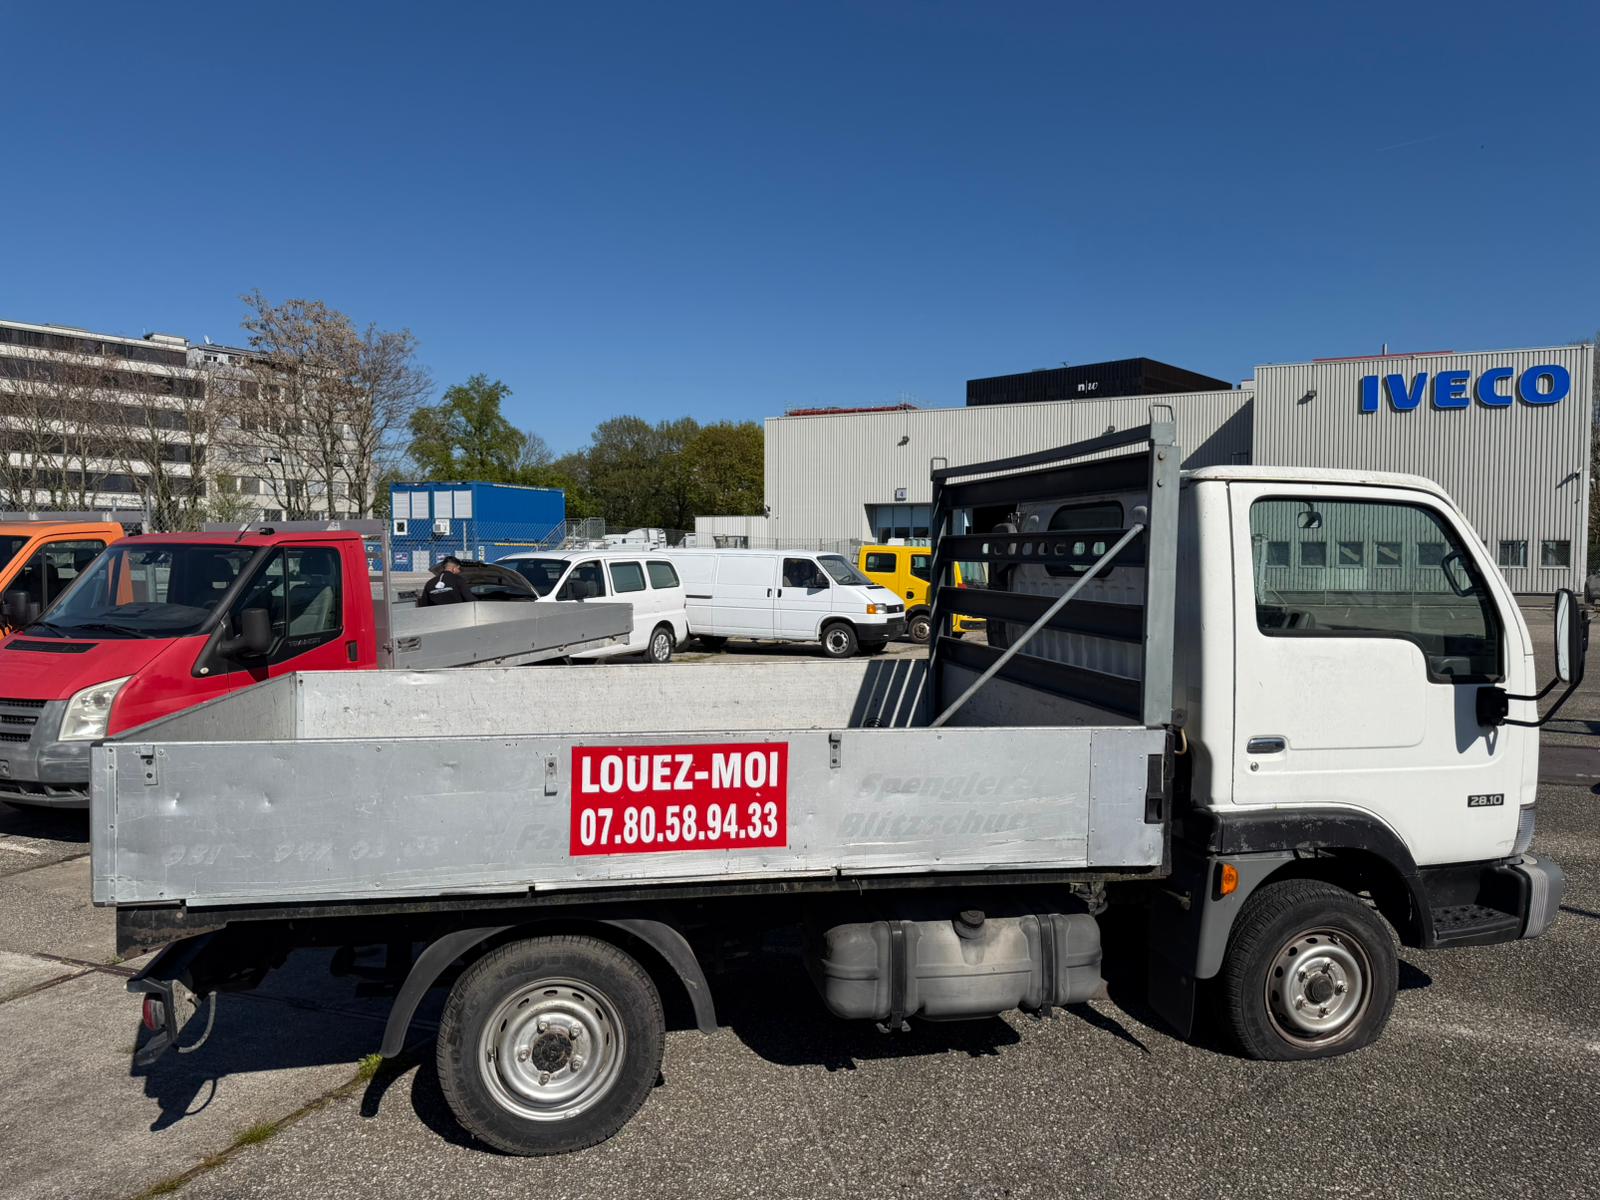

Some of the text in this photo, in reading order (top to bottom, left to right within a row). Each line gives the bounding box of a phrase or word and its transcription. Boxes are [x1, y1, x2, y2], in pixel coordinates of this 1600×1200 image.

[1362, 364, 1571, 412] IVECO
[581, 751, 779, 793] LOUEZ-MOI
[1470, 795, 1502, 806] 28.10
[580, 801, 778, 846] 07.80.58.94.33
